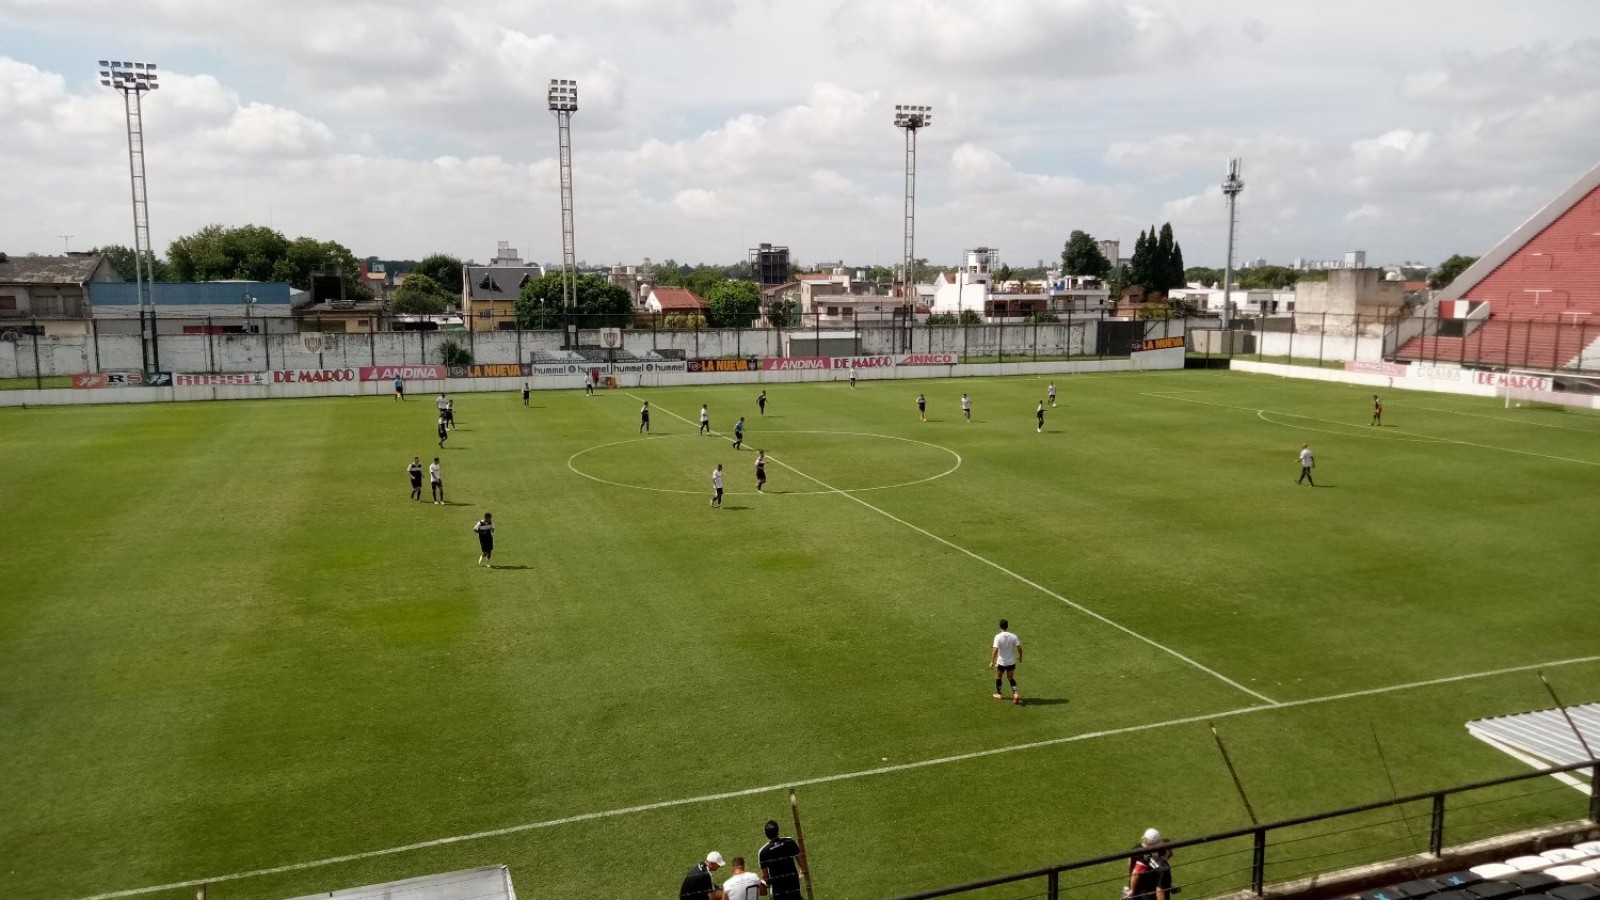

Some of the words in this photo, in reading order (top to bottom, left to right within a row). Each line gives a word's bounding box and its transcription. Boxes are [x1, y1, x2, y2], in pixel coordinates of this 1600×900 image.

[613, 363, 644, 372] hummel
[655, 362, 685, 371] hummel
[702, 360, 714, 371] LA
[717, 360, 748, 371] NUEVA
[780, 359, 824, 369] ANDINA
[834, 358, 849, 368] DE
[852, 356, 892, 368] MARCO
[273, 370, 295, 383] DE
[298, 368, 354, 383] MARCO
[382, 367, 437, 379] ANDINA
[467, 366, 481, 377] LA
[484, 364, 521, 376] NUEVA
[534, 365, 566, 374] hummel
[1478, 372, 1495, 385] DE
[1498, 374, 1548, 391] MARCO
